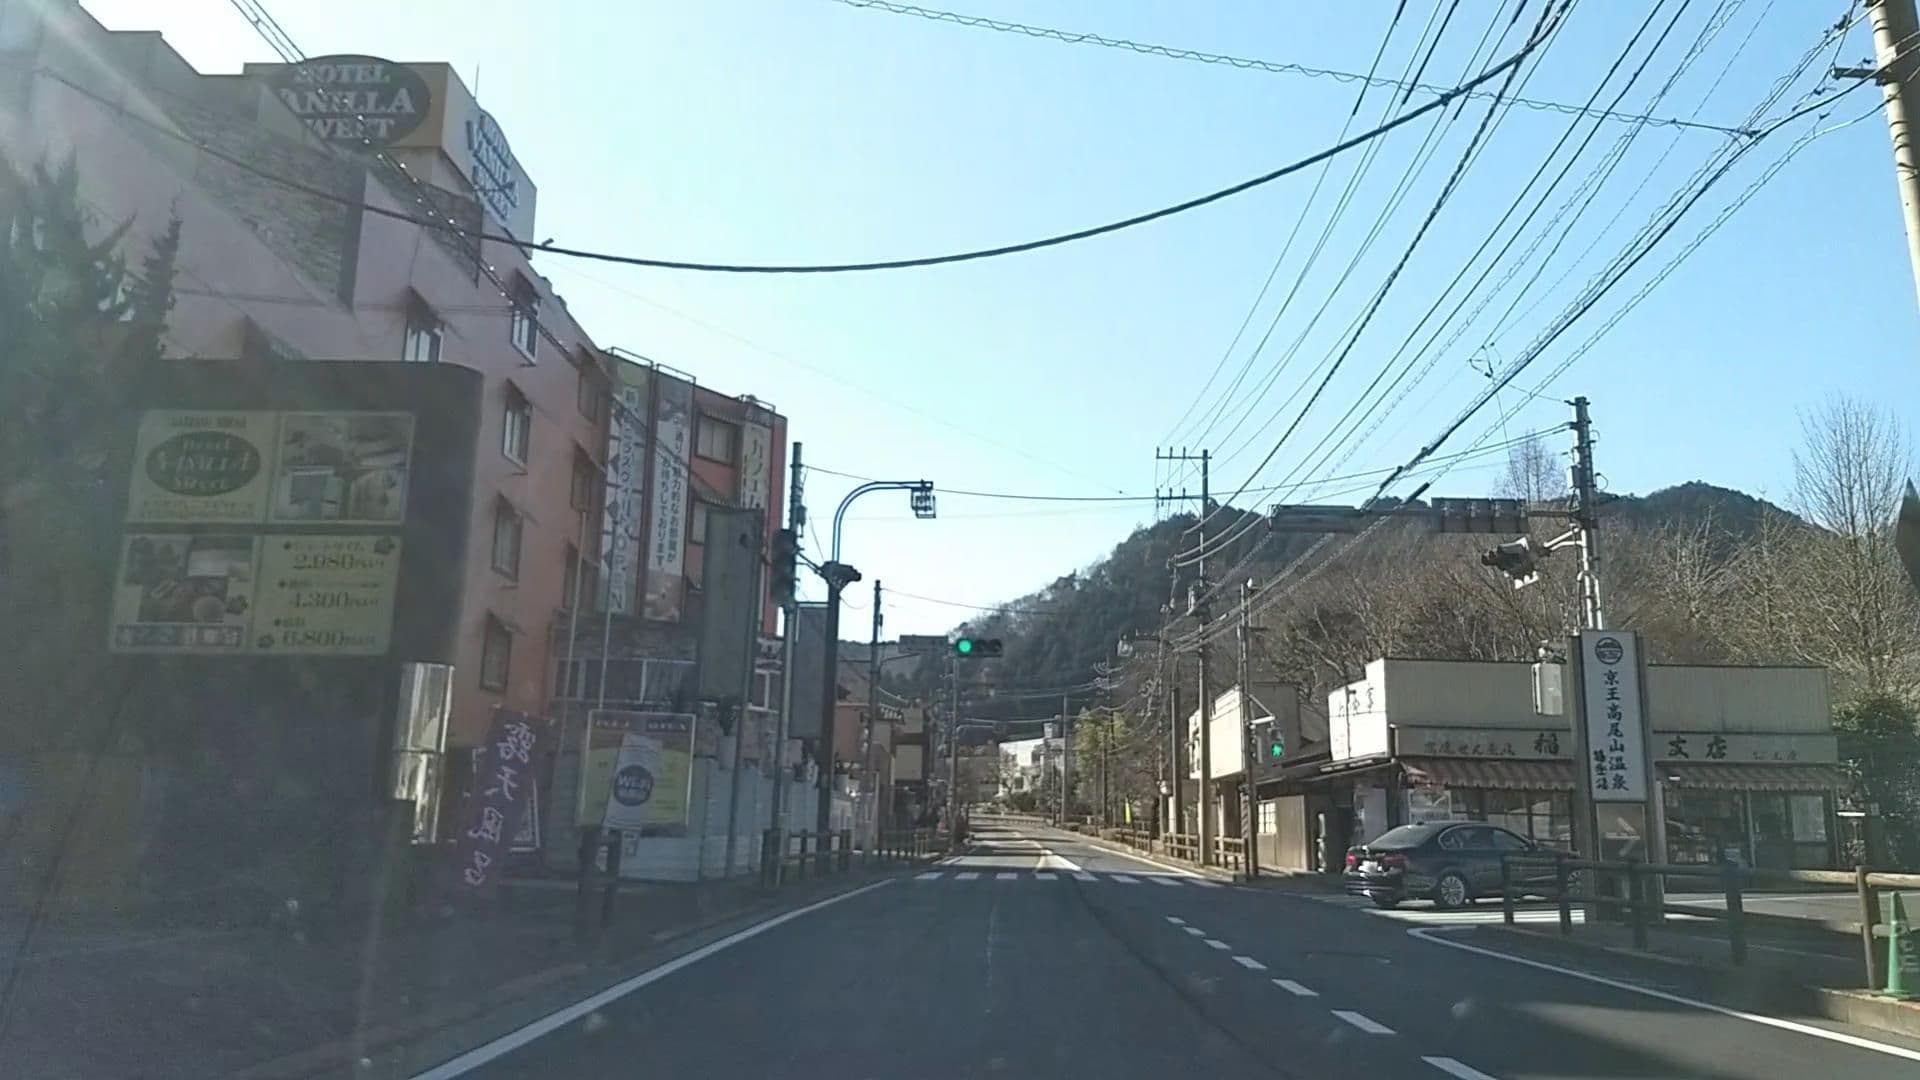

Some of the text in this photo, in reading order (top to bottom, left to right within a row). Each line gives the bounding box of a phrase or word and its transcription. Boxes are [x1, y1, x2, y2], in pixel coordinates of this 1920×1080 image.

[1602, 669, 1629, 791] 京王高尾山温泉
[1667, 735, 1728, 760] 支店
